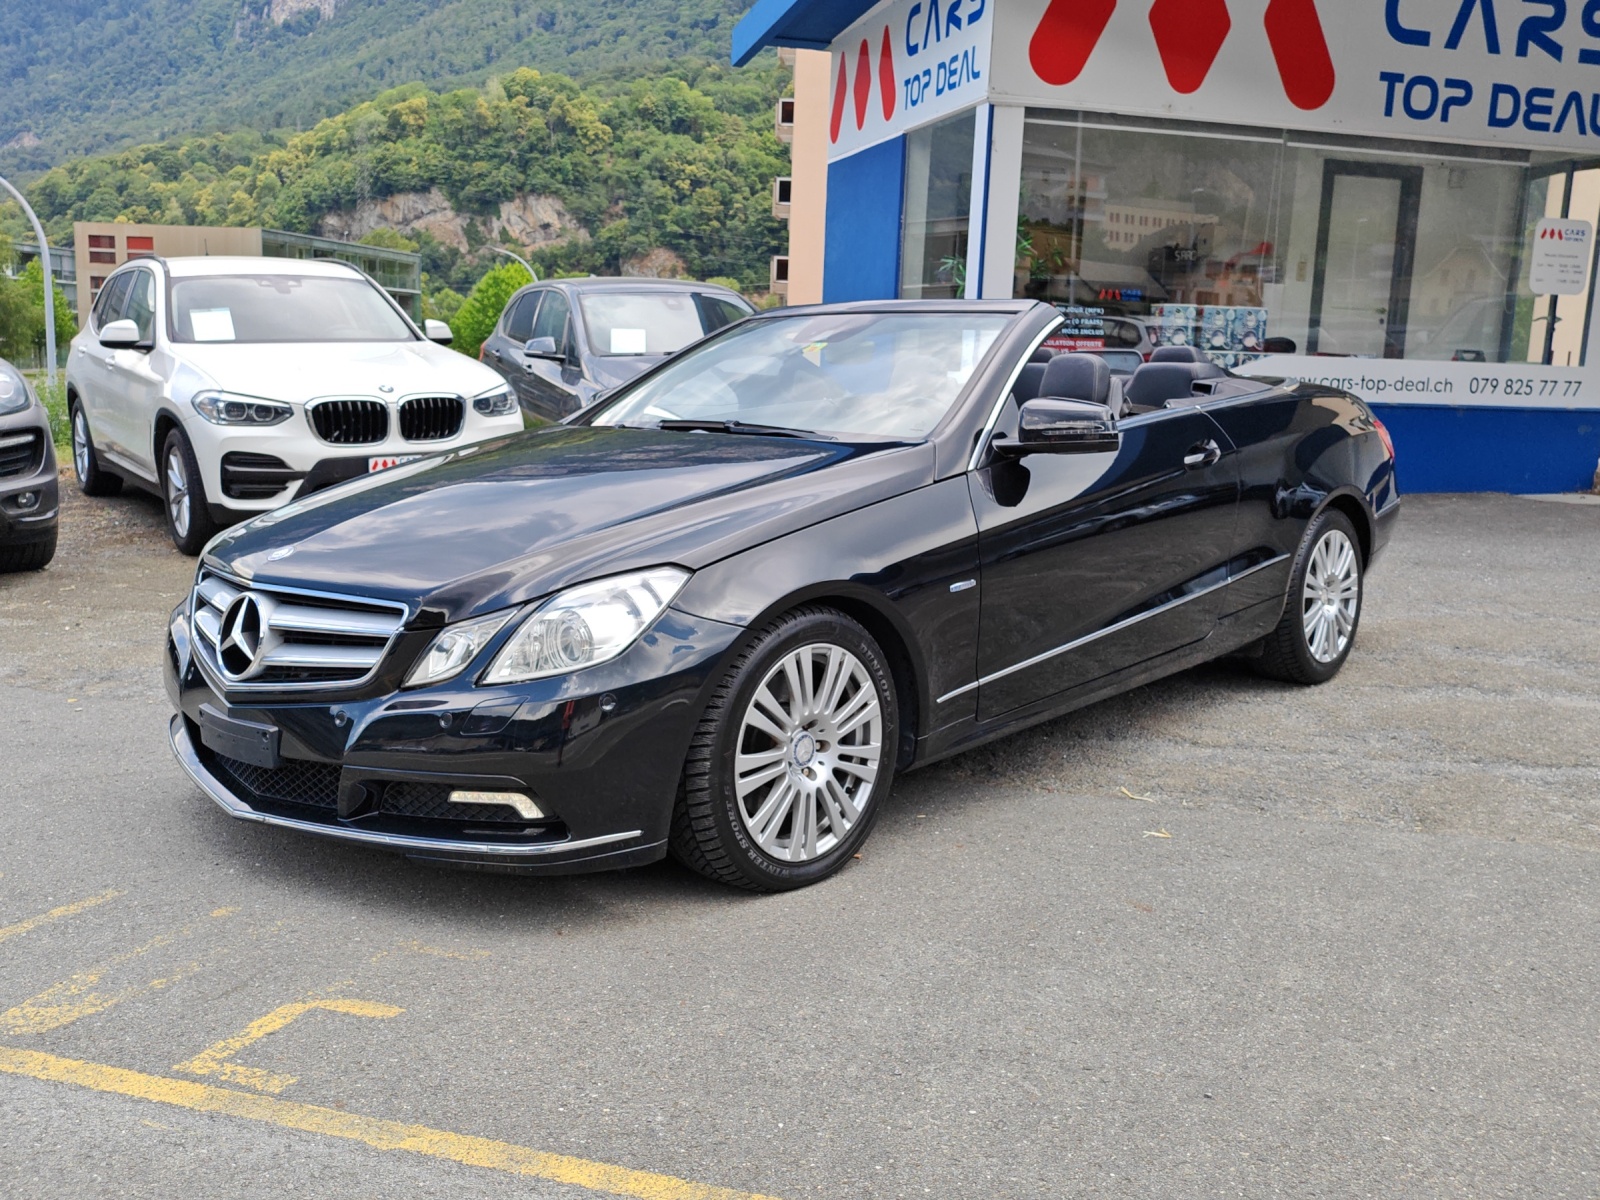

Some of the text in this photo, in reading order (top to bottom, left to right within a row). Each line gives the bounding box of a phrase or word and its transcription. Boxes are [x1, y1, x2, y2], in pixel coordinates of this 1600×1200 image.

[905, 0, 986, 57] CARS
[904, 45, 980, 111] TOP DEAL
[1379, 71, 1473, 123] TOP
[1564, 228, 1586, 237] CARS
[1469, 377, 1499, 395] 079
[1503, 379, 1534, 396] 825
[1539, 380, 1559, 397] 77
[1563, 381, 1583, 397] 77
[726, 800, 749, 849] SPORT
[747, 849, 790, 878] WINTER
